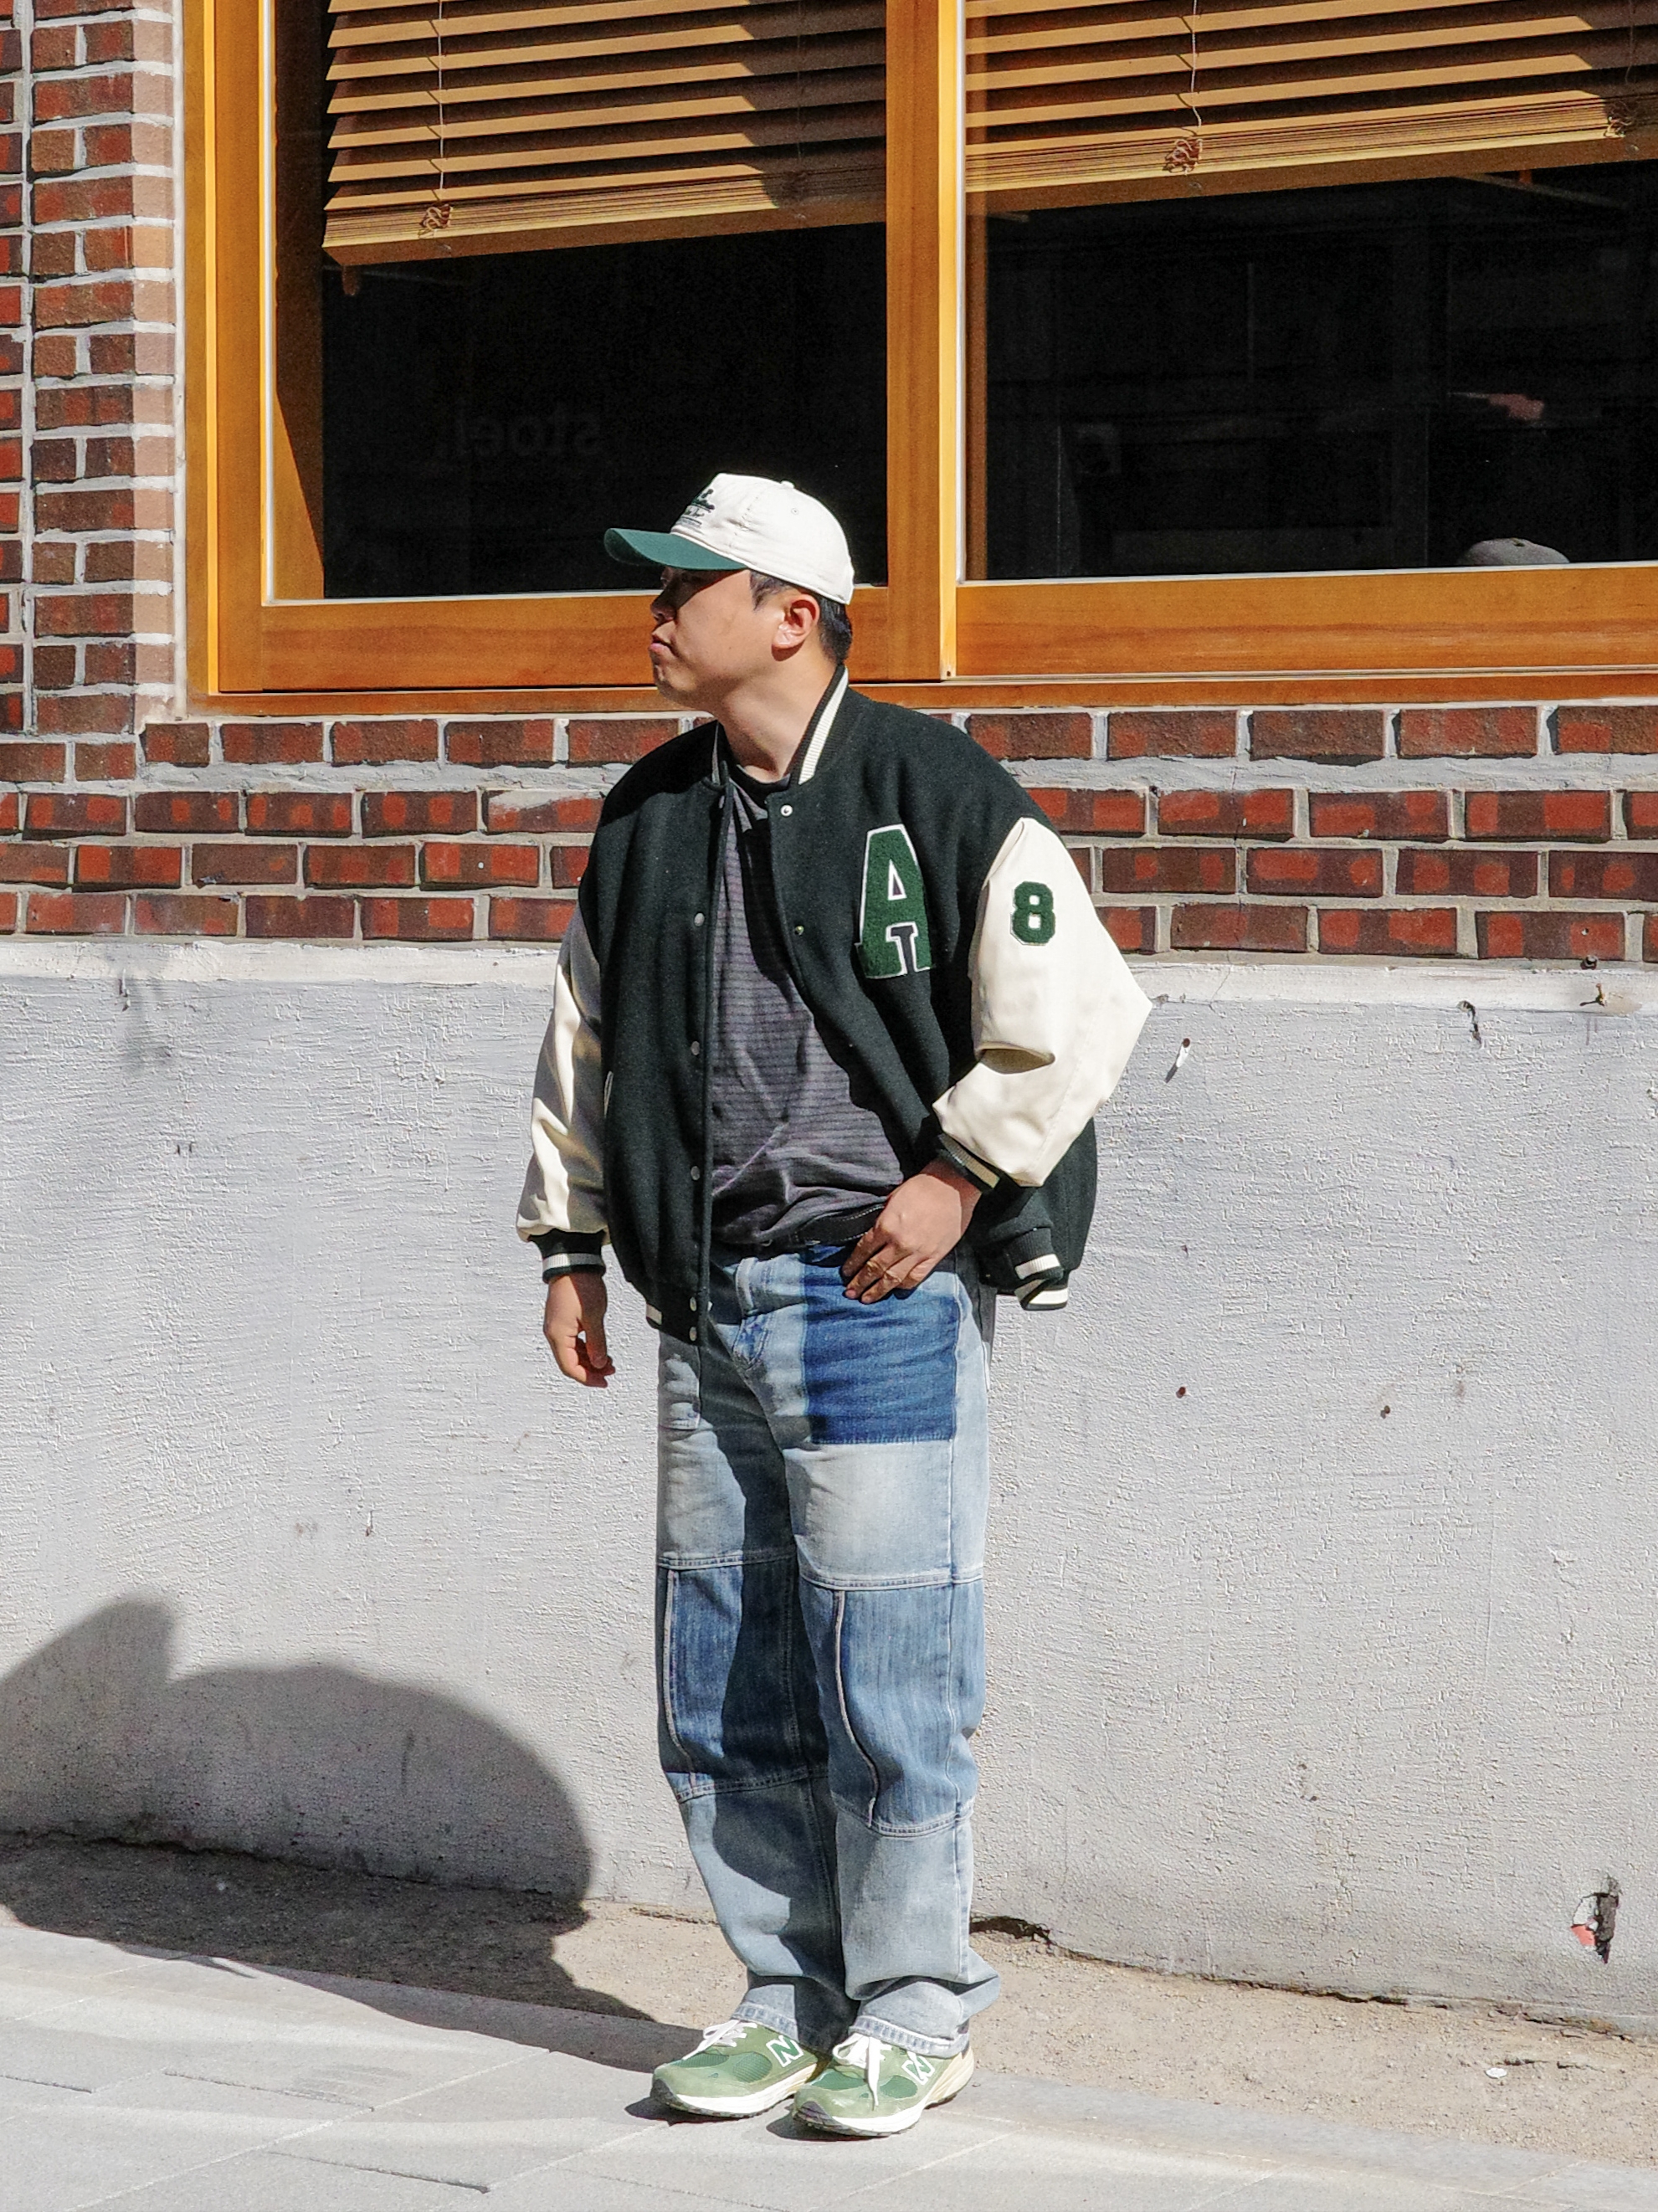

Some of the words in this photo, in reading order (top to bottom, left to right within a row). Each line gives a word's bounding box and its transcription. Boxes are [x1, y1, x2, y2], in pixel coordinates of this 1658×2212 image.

[1010, 880, 1056, 946] 8
[765, 2035, 804, 2068] N
[901, 2050, 937, 2085] N
